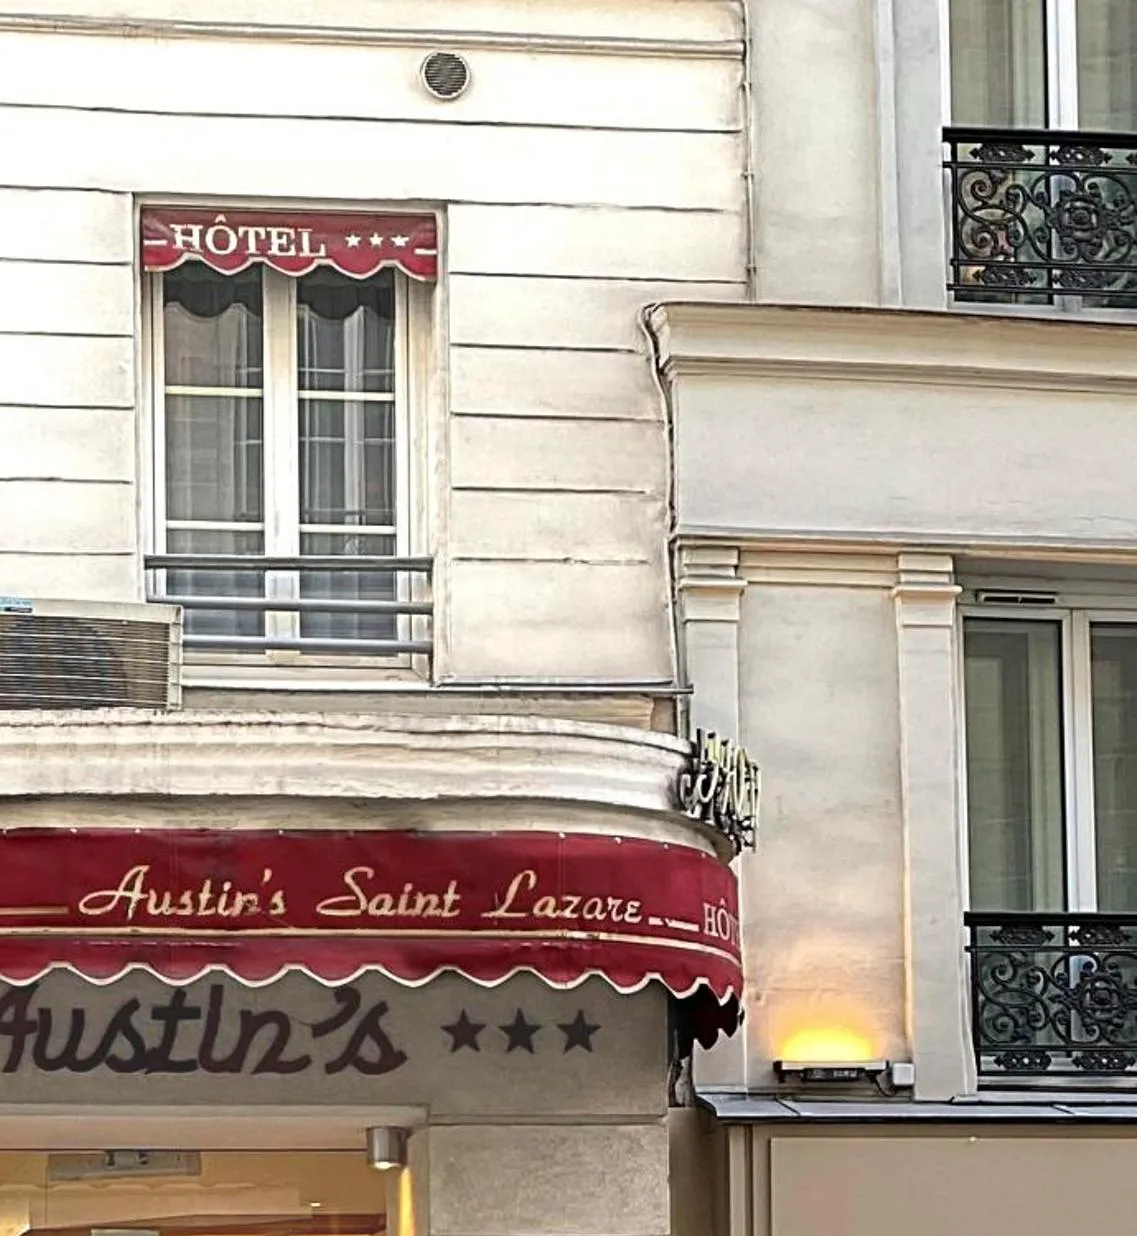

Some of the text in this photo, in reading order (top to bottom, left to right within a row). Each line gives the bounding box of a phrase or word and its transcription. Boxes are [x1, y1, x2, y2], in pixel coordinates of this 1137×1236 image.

[169, 214, 327, 257] HÔTEL
[78, 865, 642, 923] Austin's Saint Lazare
